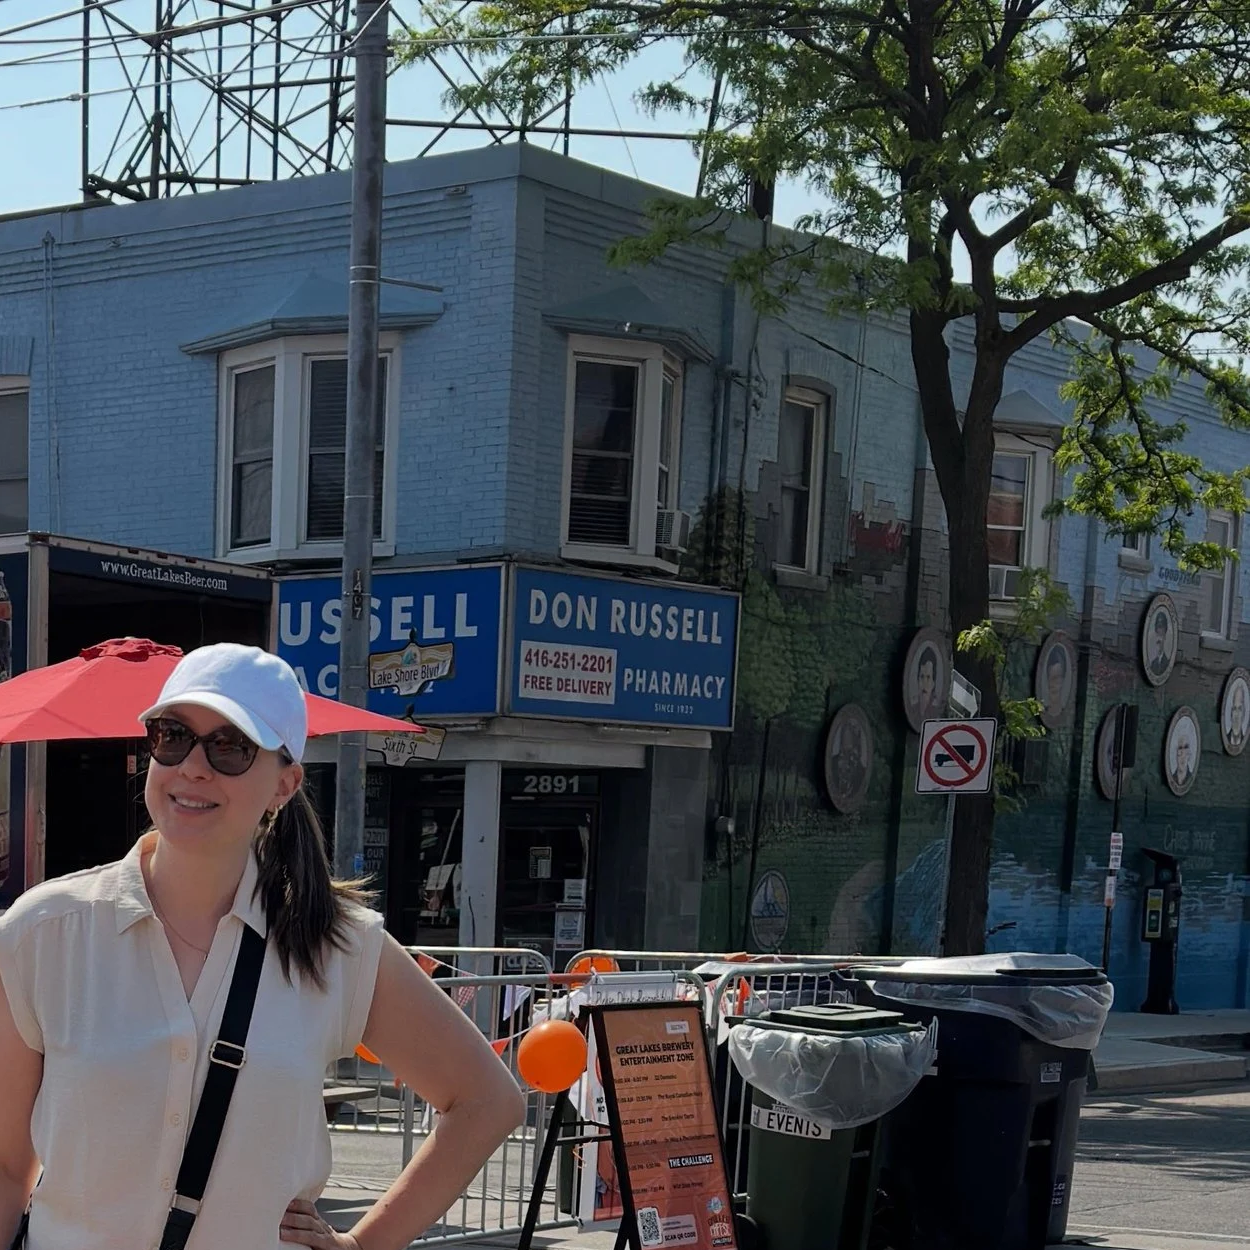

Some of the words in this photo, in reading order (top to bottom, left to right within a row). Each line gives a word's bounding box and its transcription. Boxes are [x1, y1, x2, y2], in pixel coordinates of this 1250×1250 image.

[100, 560, 228, 591] www.GreatLakesBeer.com
[529, 588, 598, 631] DON
[610, 598, 723, 645] RUSSELL
[524, 648, 612, 673] 416-251-2201
[372, 670, 392, 686] Lake
[394, 668, 419, 683] Shore
[420, 663, 440, 679] Blvd
[623, 667, 726, 699] PHARMACY
[523, 674, 553, 691] FREE
[556, 677, 612, 696] DELIVERY
[654, 703, 674, 713] SINCE
[381, 737, 406, 754] Sixth
[407, 741, 418, 756] St
[523, 775, 580, 794] 2891
[616, 1044, 640, 1055] GREAT
[640, 1043, 662, 1053] LAKES
[662, 1041, 695, 1052] BREWERY
[620, 1054, 675, 1067] ENTERTAINMENT
[676, 1053, 695, 1062] ZONE
[669, 1158, 681, 1168] THE
[681, 1154, 713, 1167] CHALLENGE
[665, 1234, 678, 1242] SCAN
[678, 1233, 684, 1241] QR
[684, 1231, 696, 1239] CODE
